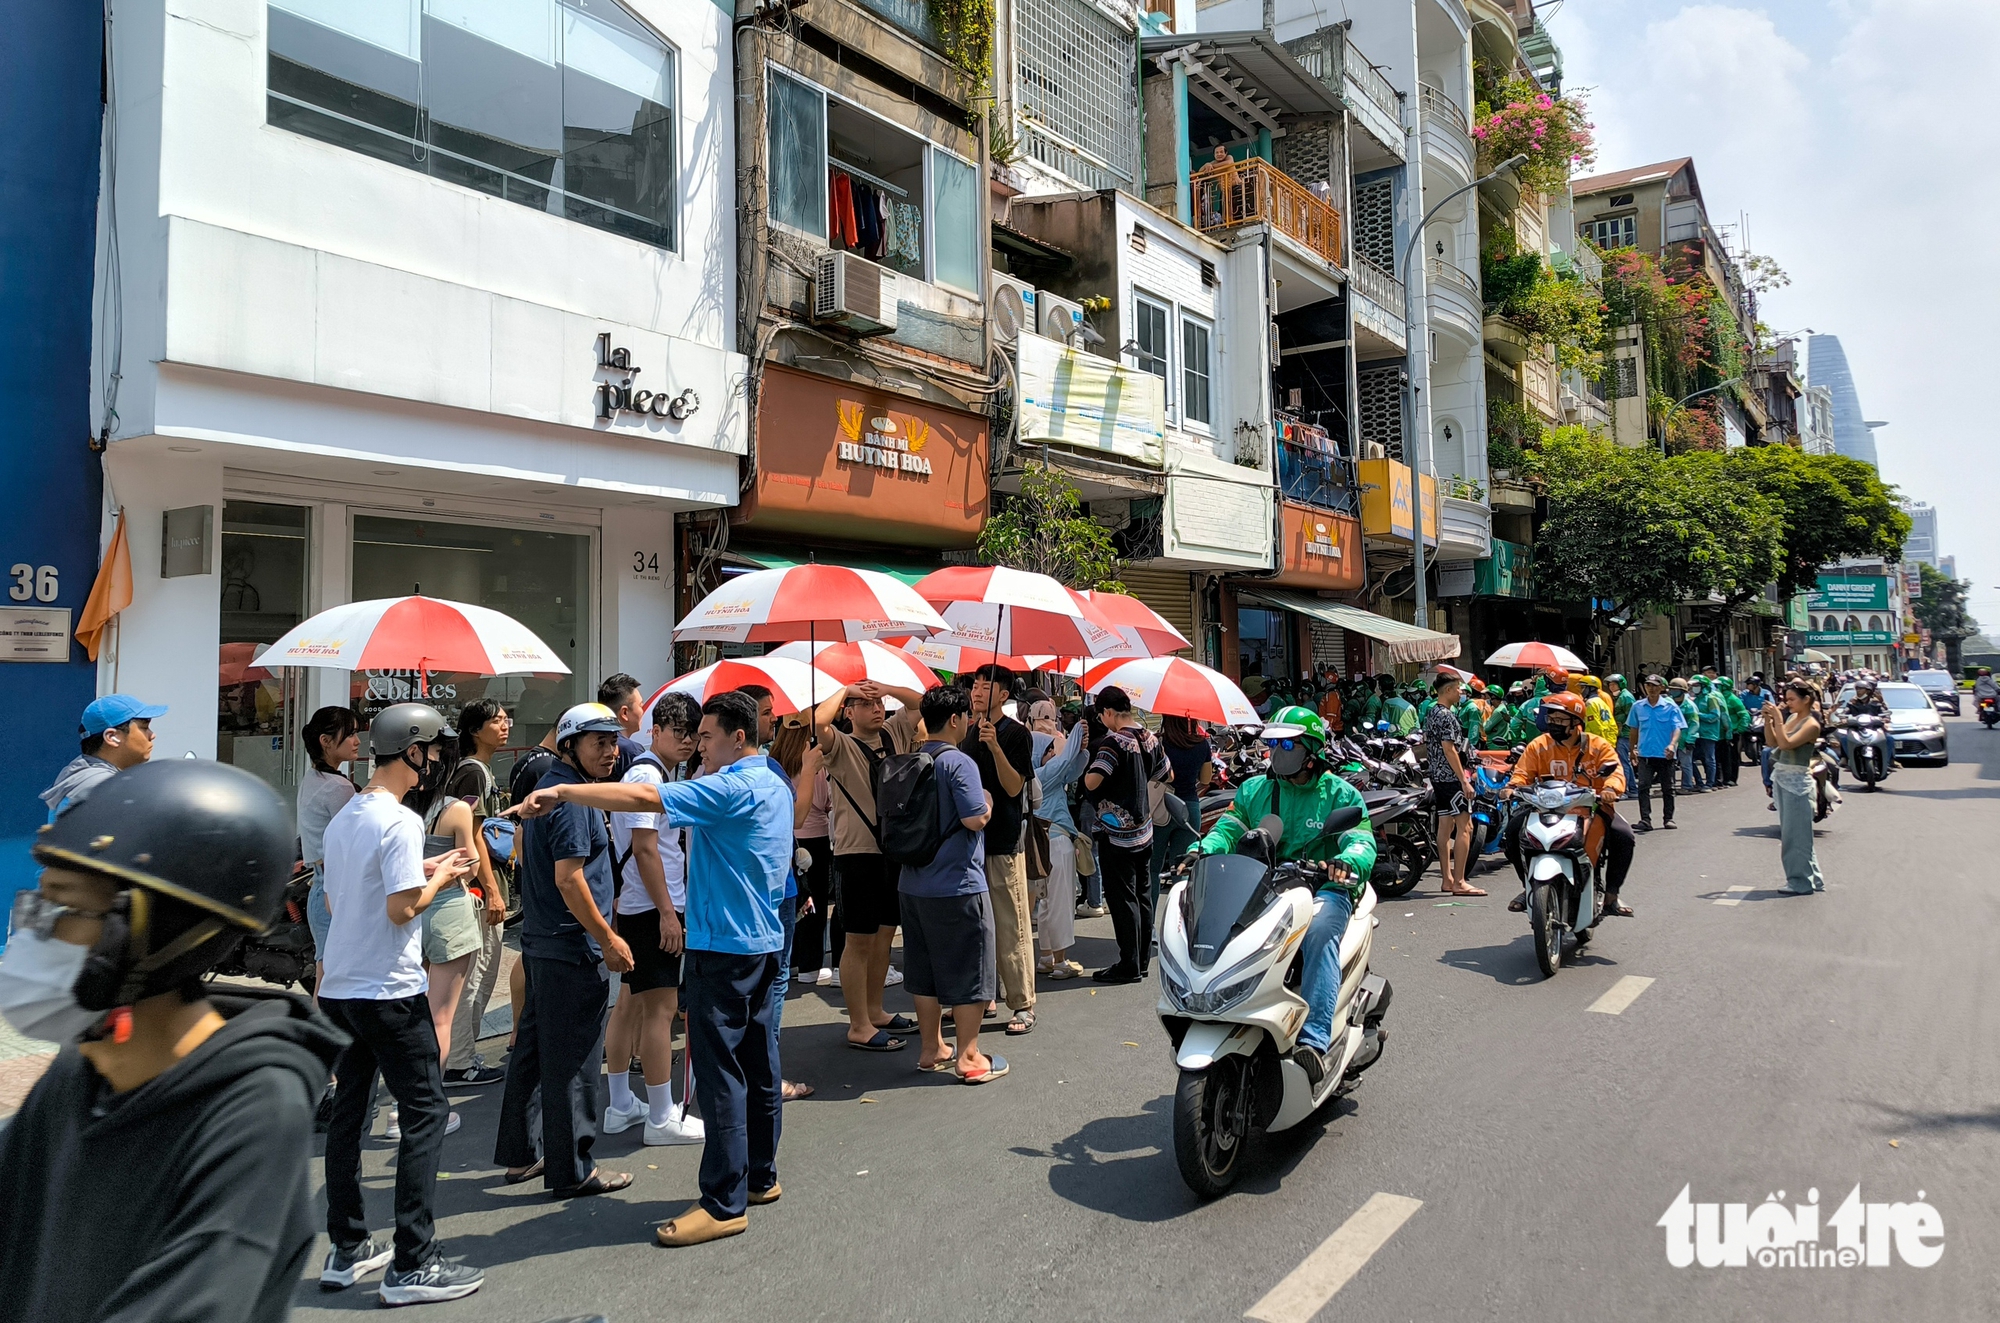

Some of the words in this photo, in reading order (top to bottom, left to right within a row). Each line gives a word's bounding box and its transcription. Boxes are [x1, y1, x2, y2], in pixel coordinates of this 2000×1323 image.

[598, 332, 636, 371] la
[597, 379, 689, 420] piece
[865, 430, 896, 448] BÁNH
[896, 436, 908, 451] MÌ
[839, 441, 899, 468] HUYNH
[900, 453, 933, 475] HOA
[633, 551, 659, 574] 34
[9, 563, 59, 603] 36
[1827, 583, 1850, 592] DANNY
[1850, 584, 1875, 592] GREEN
